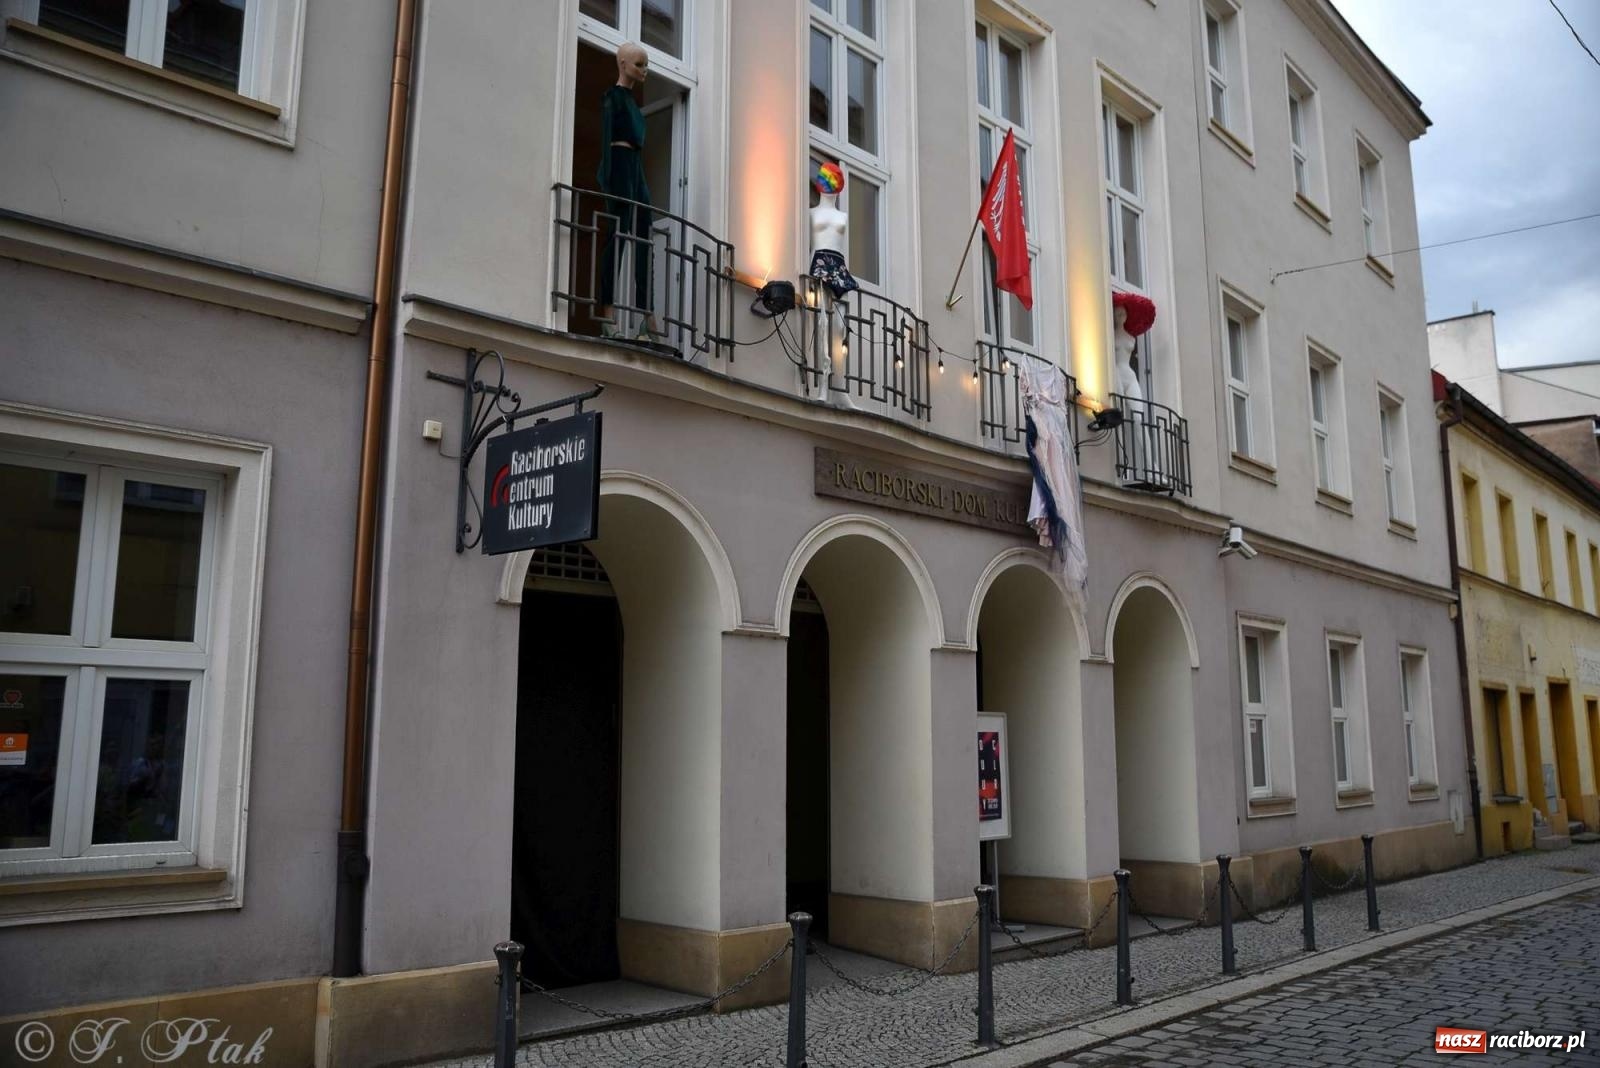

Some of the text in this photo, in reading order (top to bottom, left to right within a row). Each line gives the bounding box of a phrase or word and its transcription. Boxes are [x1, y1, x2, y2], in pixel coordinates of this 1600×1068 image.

[511, 436, 585, 475] Raciborskie
[834, 463, 1027, 526] RACIBORSKI DOM KUL
[508, 501, 554, 529] Kultury
